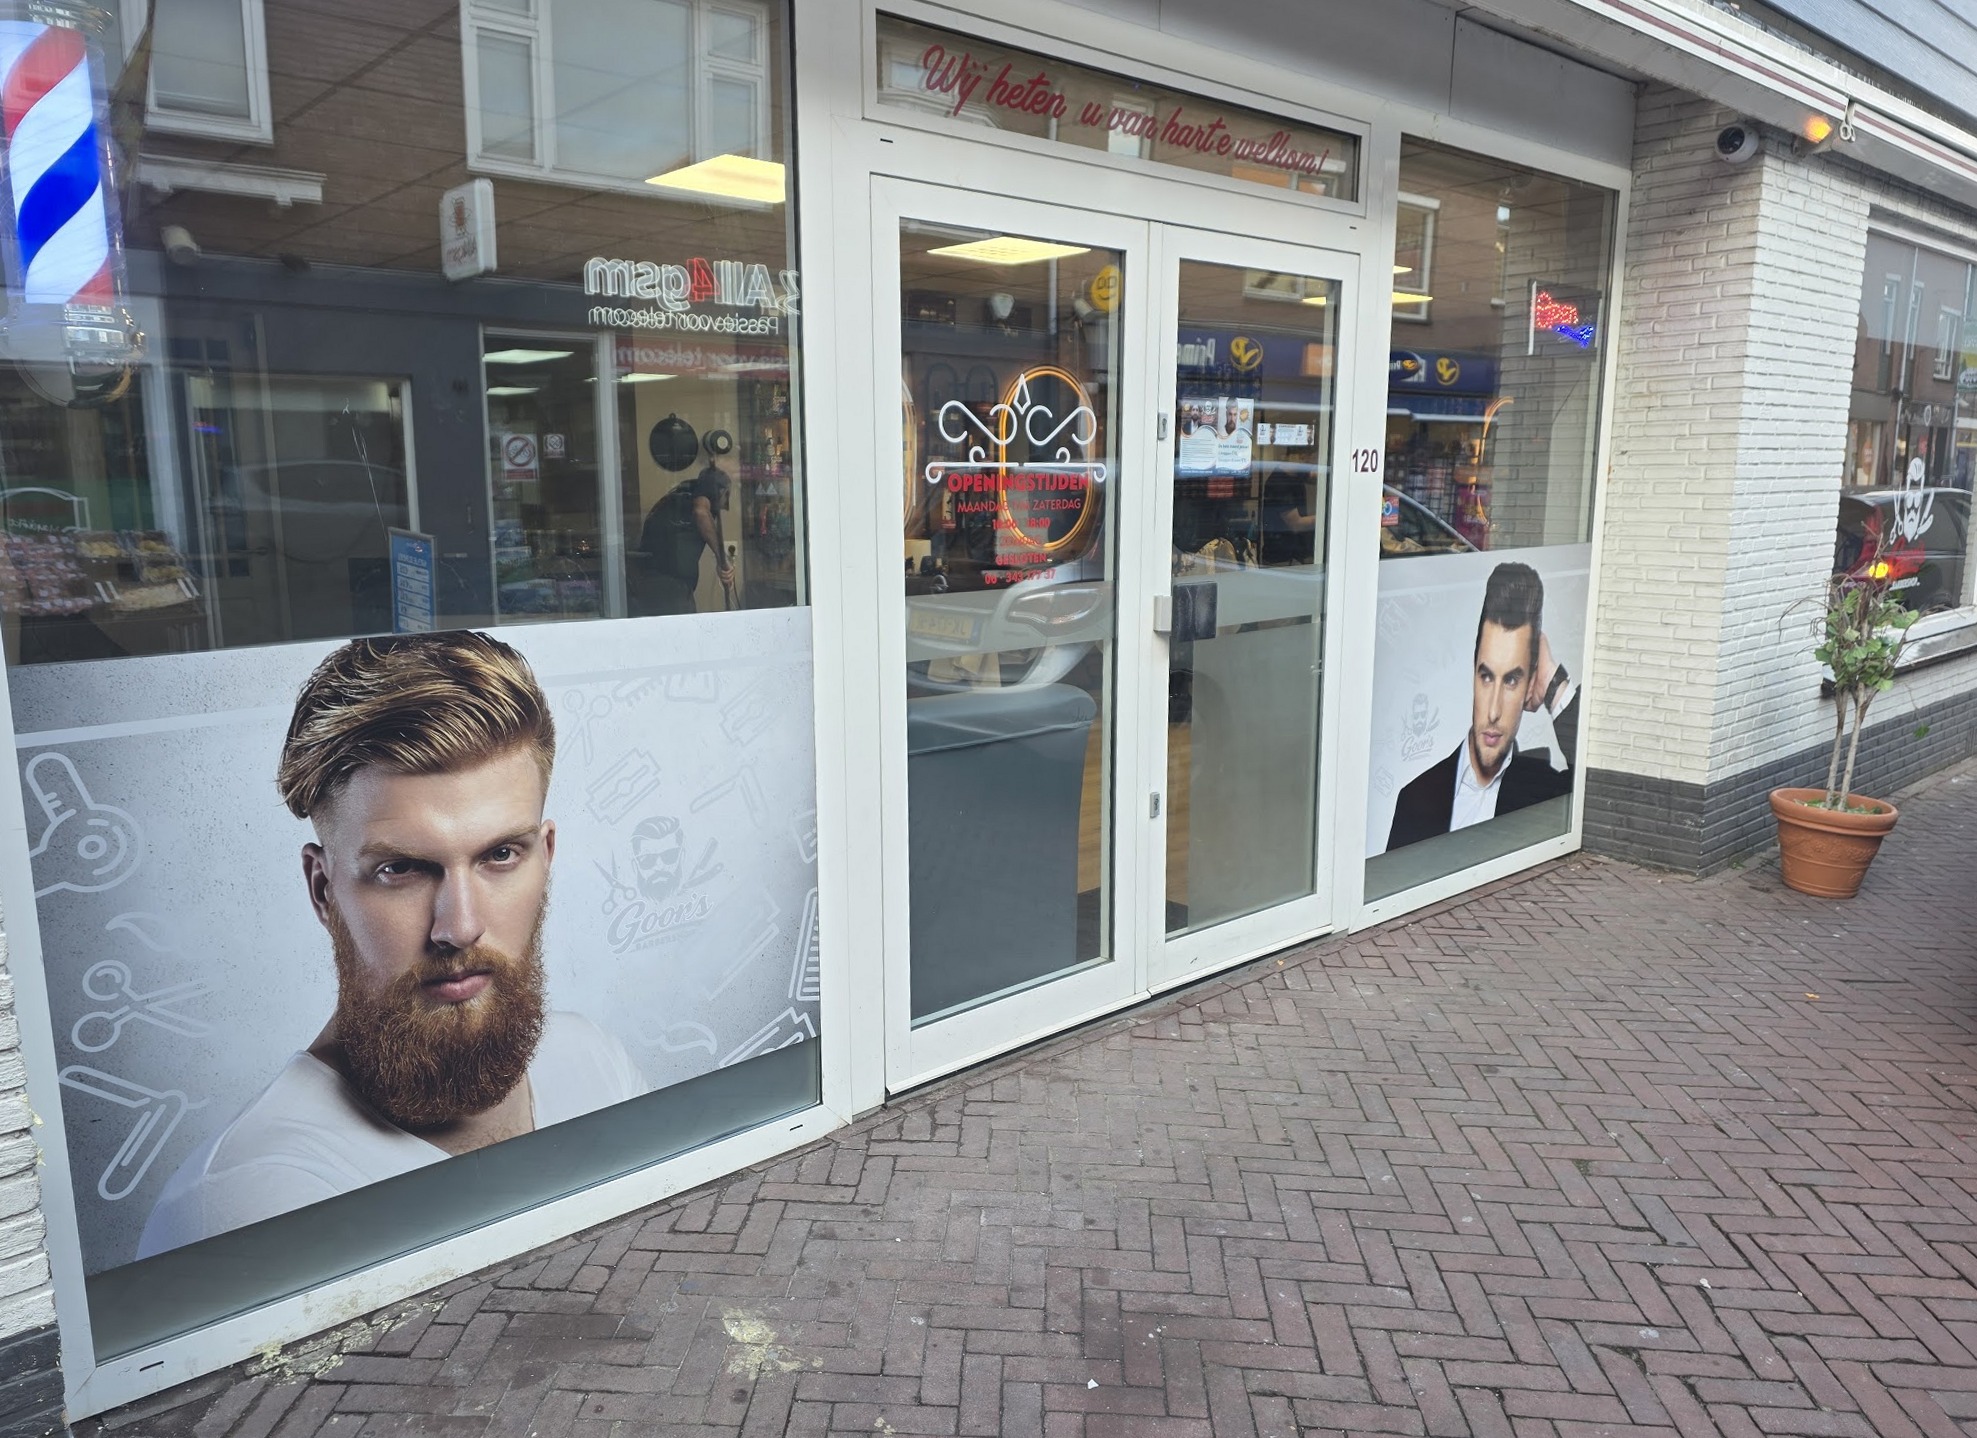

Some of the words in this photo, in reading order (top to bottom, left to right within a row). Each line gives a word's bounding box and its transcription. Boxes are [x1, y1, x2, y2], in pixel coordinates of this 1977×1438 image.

[923, 44, 988, 117] Wij
[986, 63, 1067, 119] heten
[1080, 102, 1104, 126] u
[1106, 107, 1159, 139] van
[1234, 130, 1330, 175] welkom!
[1352, 449, 1378, 472] 120
[948, 473, 1089, 492] OPENINGSTIJDEN
[1032, 498, 1081, 512] ZATERDAG
[995, 552, 1047, 566] GESLOTEN
[606, 893, 713, 954] Goor's
